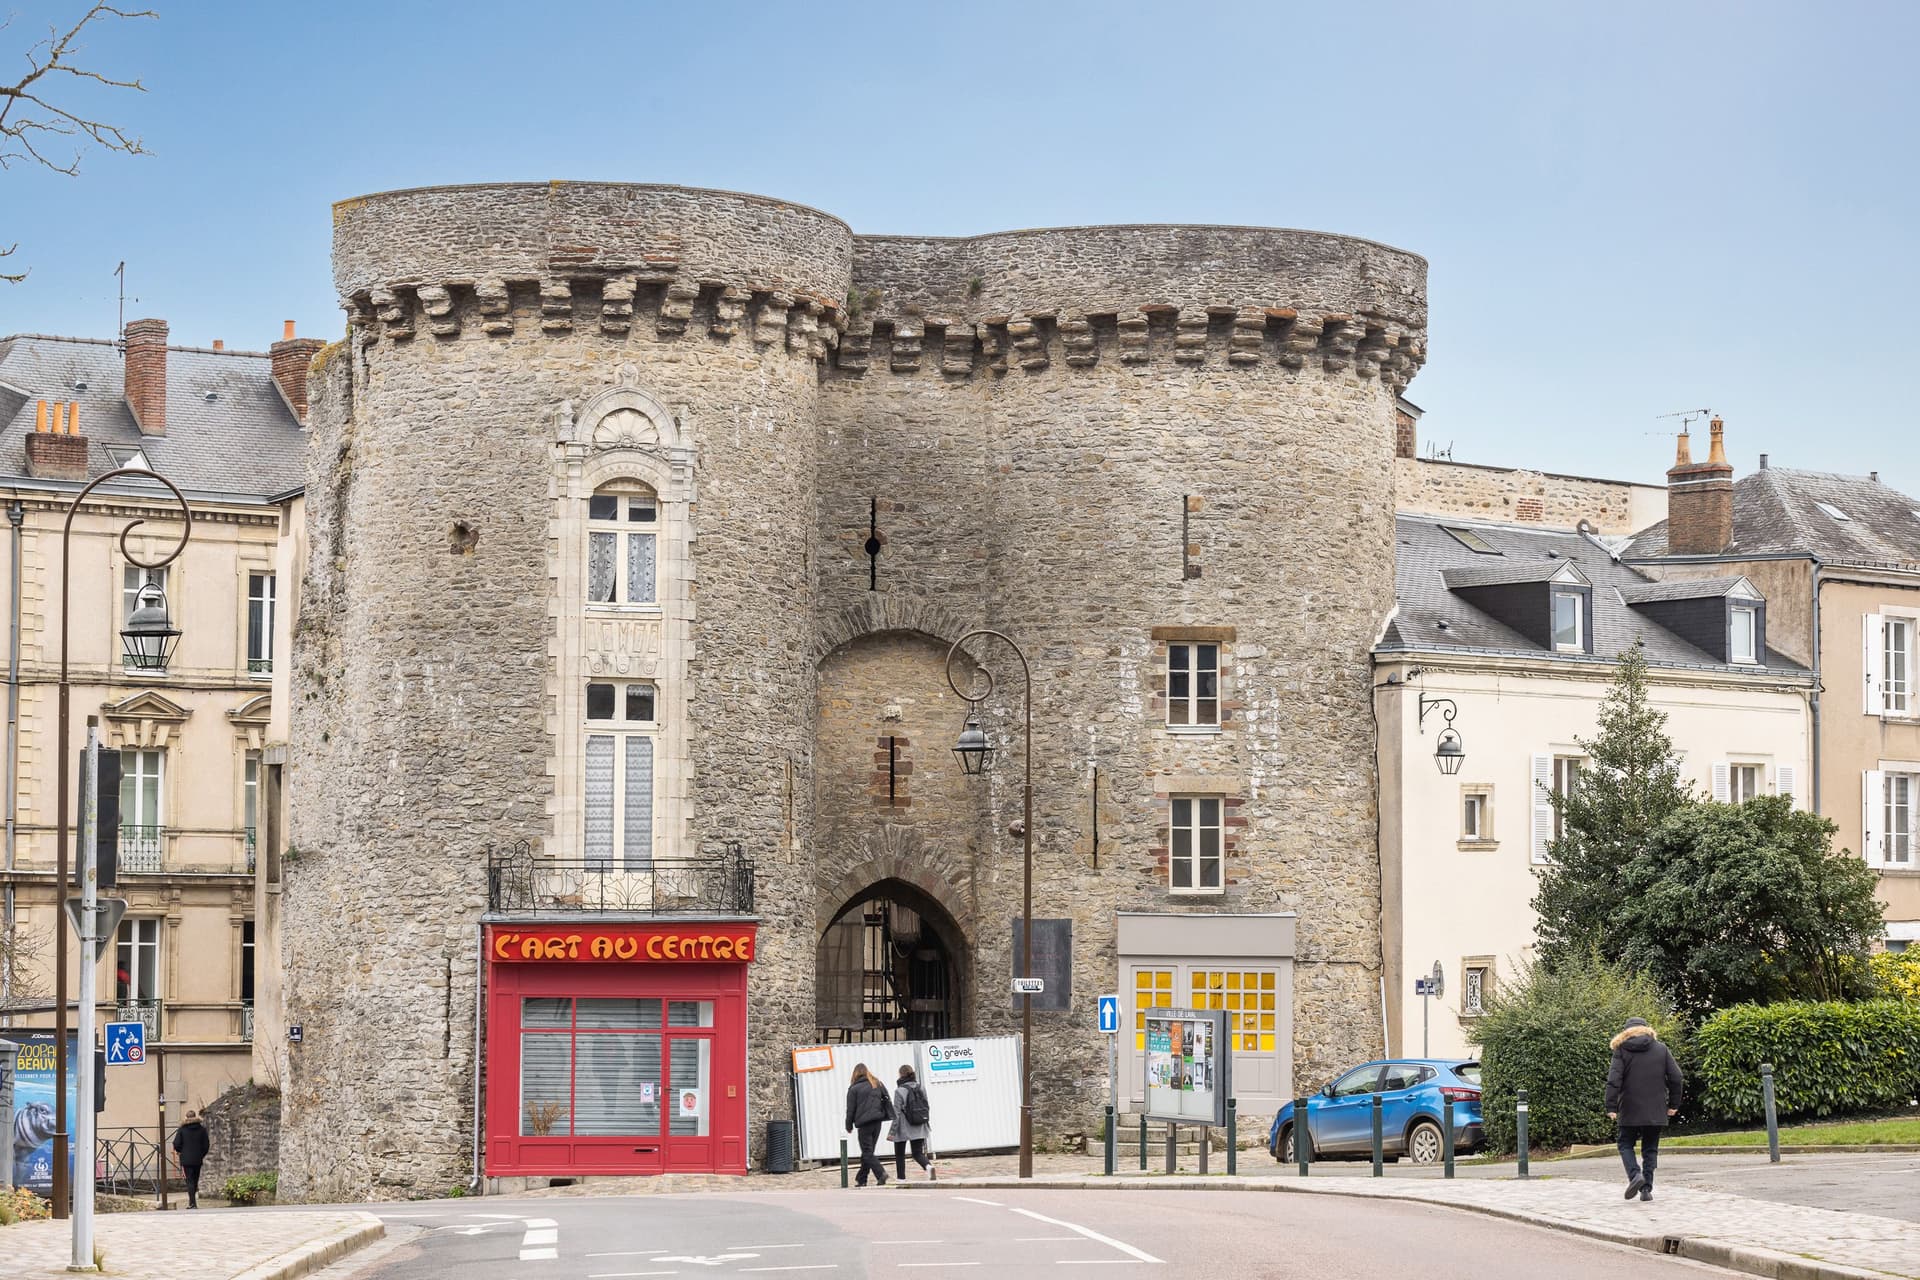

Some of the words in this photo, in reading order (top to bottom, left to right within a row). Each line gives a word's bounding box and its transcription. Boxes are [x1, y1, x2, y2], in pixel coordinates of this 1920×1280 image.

[495, 934, 582, 960] C'ART
[591, 935, 638, 960] AU
[646, 934, 750, 960] CENTRE
[17, 1058, 69, 1071] BEAUV
